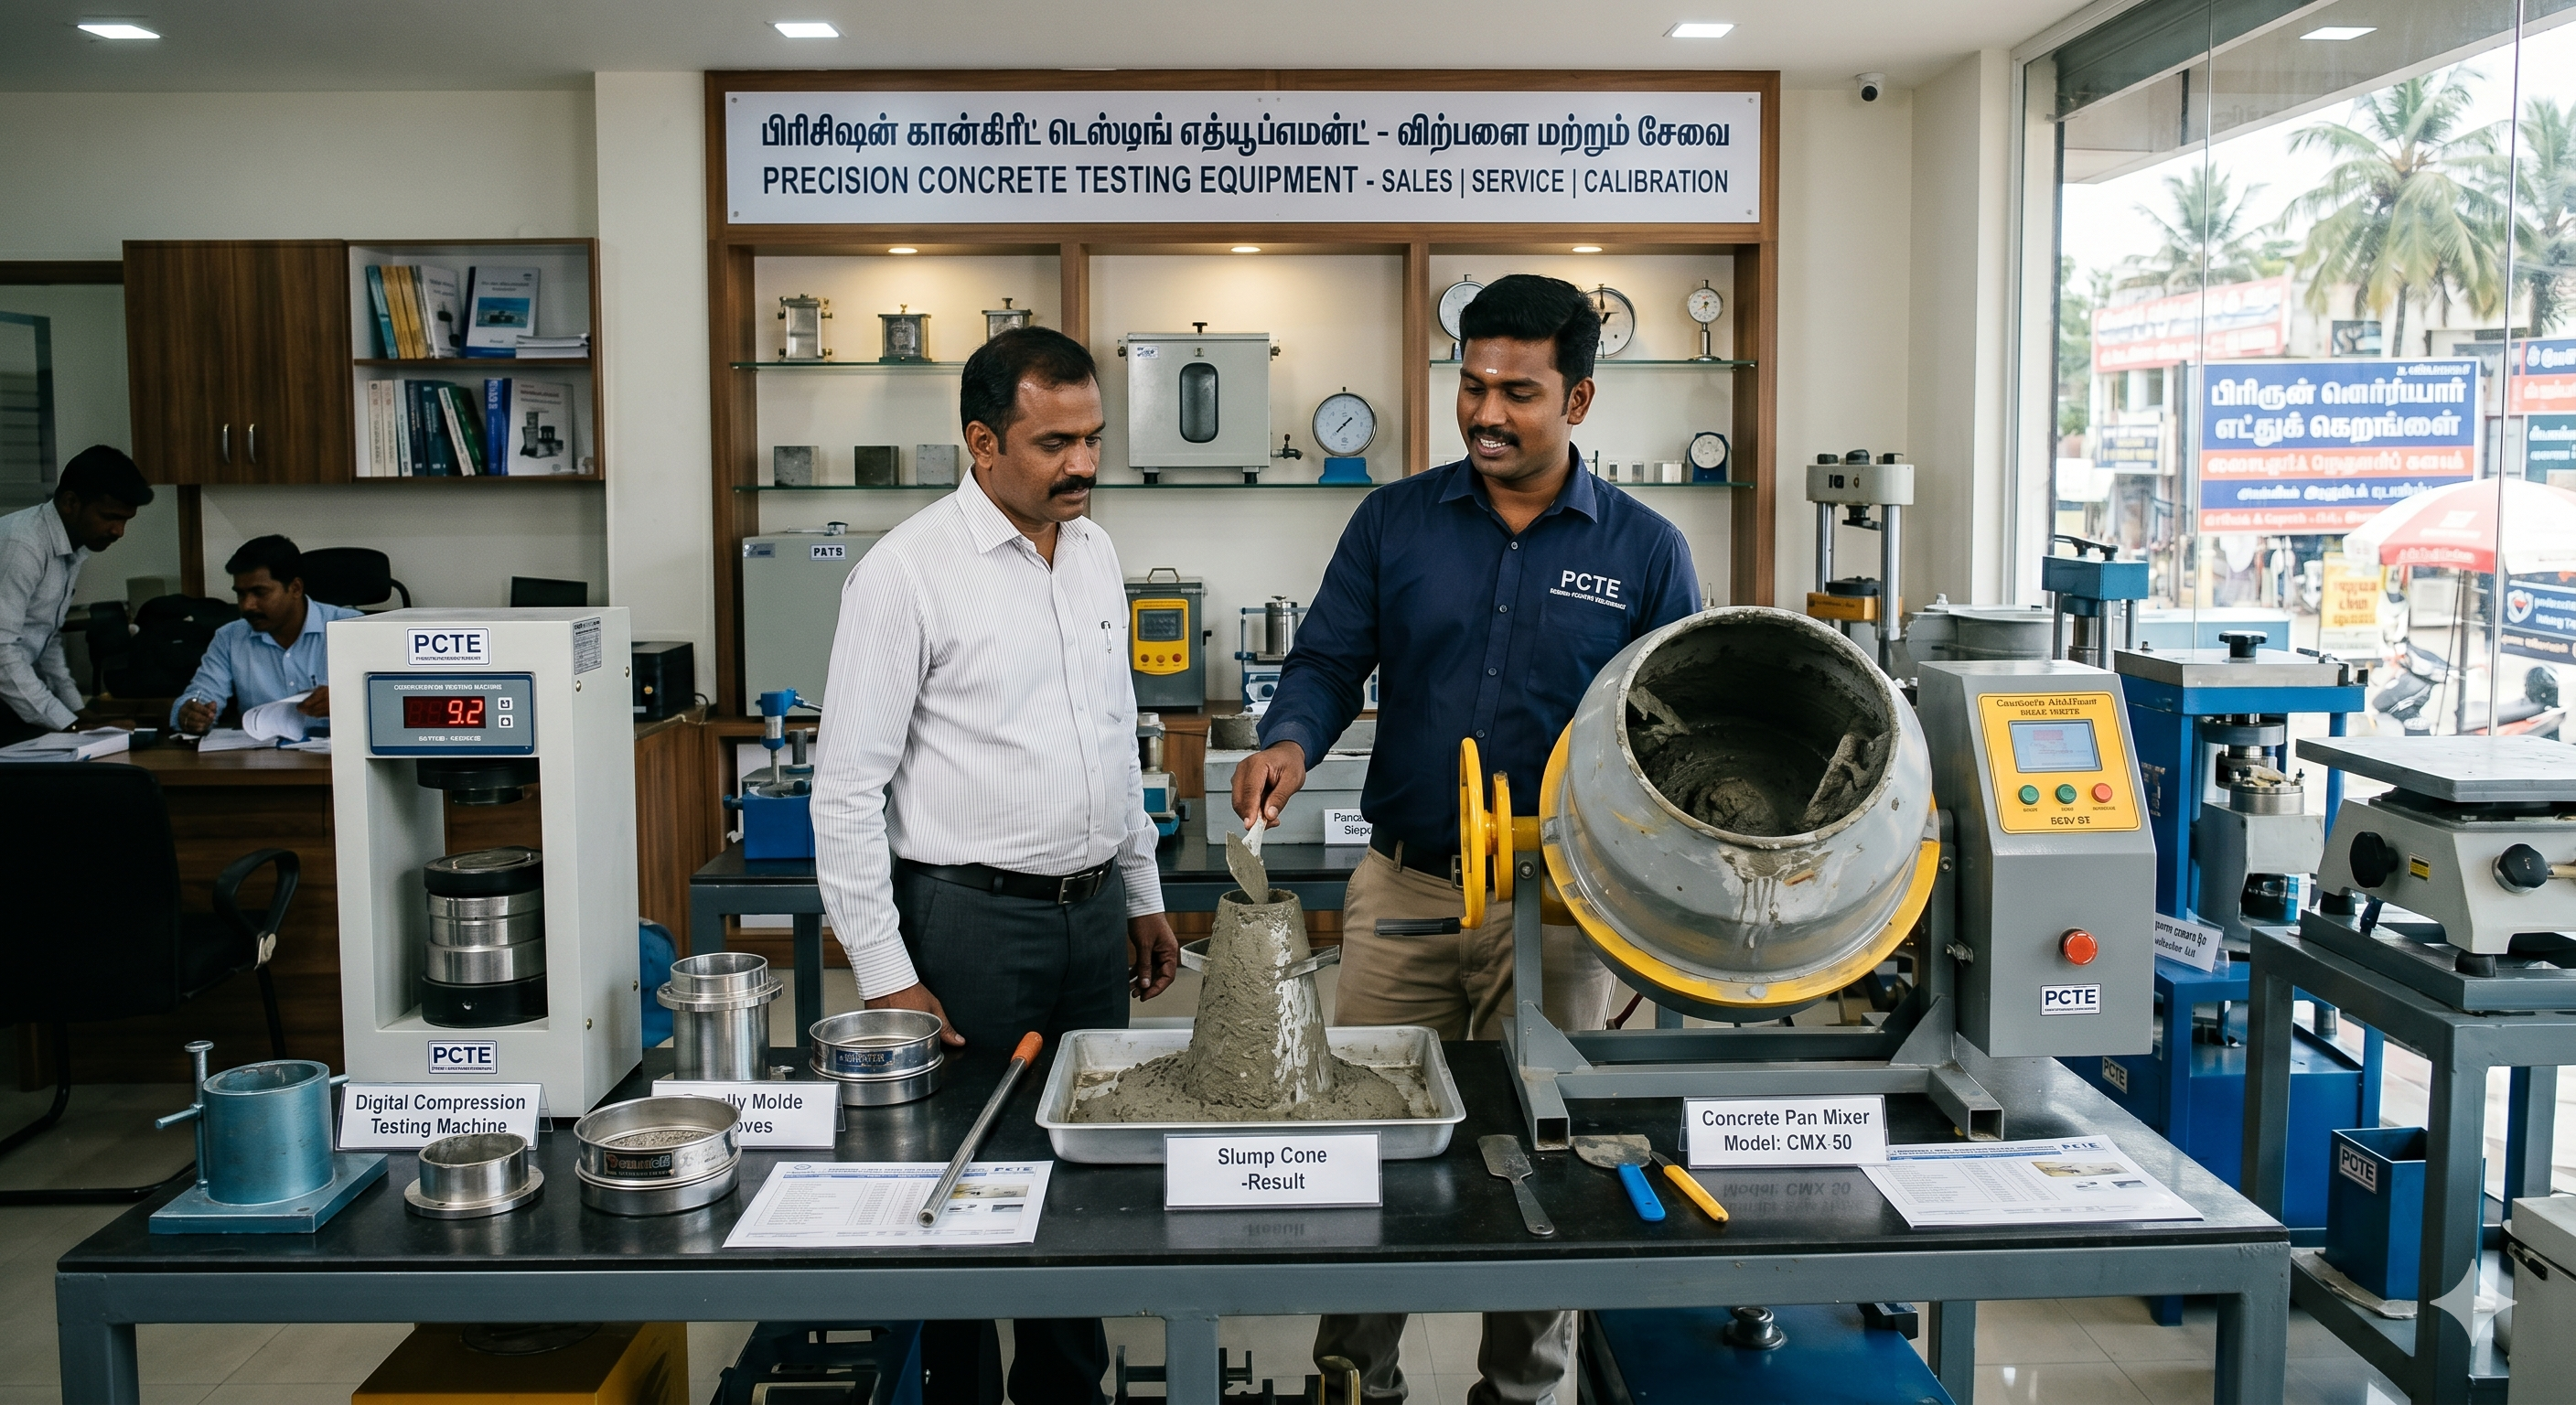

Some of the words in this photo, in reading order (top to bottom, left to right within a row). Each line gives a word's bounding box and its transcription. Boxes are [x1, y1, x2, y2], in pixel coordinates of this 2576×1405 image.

[1538, 113, 1630, 157] மற்றும்
[1637, 114, 1730, 146] சேவை
[763, 166, 908, 195] PRECISION
[918, 166, 1068, 194] CONCRETE
[1075, 166, 1191, 194] TESTING
[1200, 166, 1358, 196] EQUIPMENT
[1381, 168, 1453, 193] SALES
[1472, 168, 1564, 193] SERVICE
[1584, 168, 1728, 193] CALIBRATION
[813, 547, 843, 557] PATS
[1560, 569, 1622, 599] PCTE
[414, 634, 481, 654] PCTE
[448, 700, 484, 724] 9.2
[2045, 989, 2097, 1006] PCTE
[433, 1046, 492, 1064] PCTE
[356, 1094, 409, 1114] Digital
[413, 1094, 526, 1114] Compression
[752, 1093, 803, 1110] Molde
[1702, 1110, 1779, 1126] Concrete
[1785, 1109, 1818, 1126] Pan
[1823, 1109, 1870, 1125] Mixer
[370, 1118, 432, 1138] Testing
[436, 1118, 508, 1134] Machine
[1724, 1134, 1781, 1152] Model:
[1218, 1147, 1275, 1168] Slump
[1281, 1146, 1327, 1164] Cone
[1241, 1172, 1305, 1190] -Result
